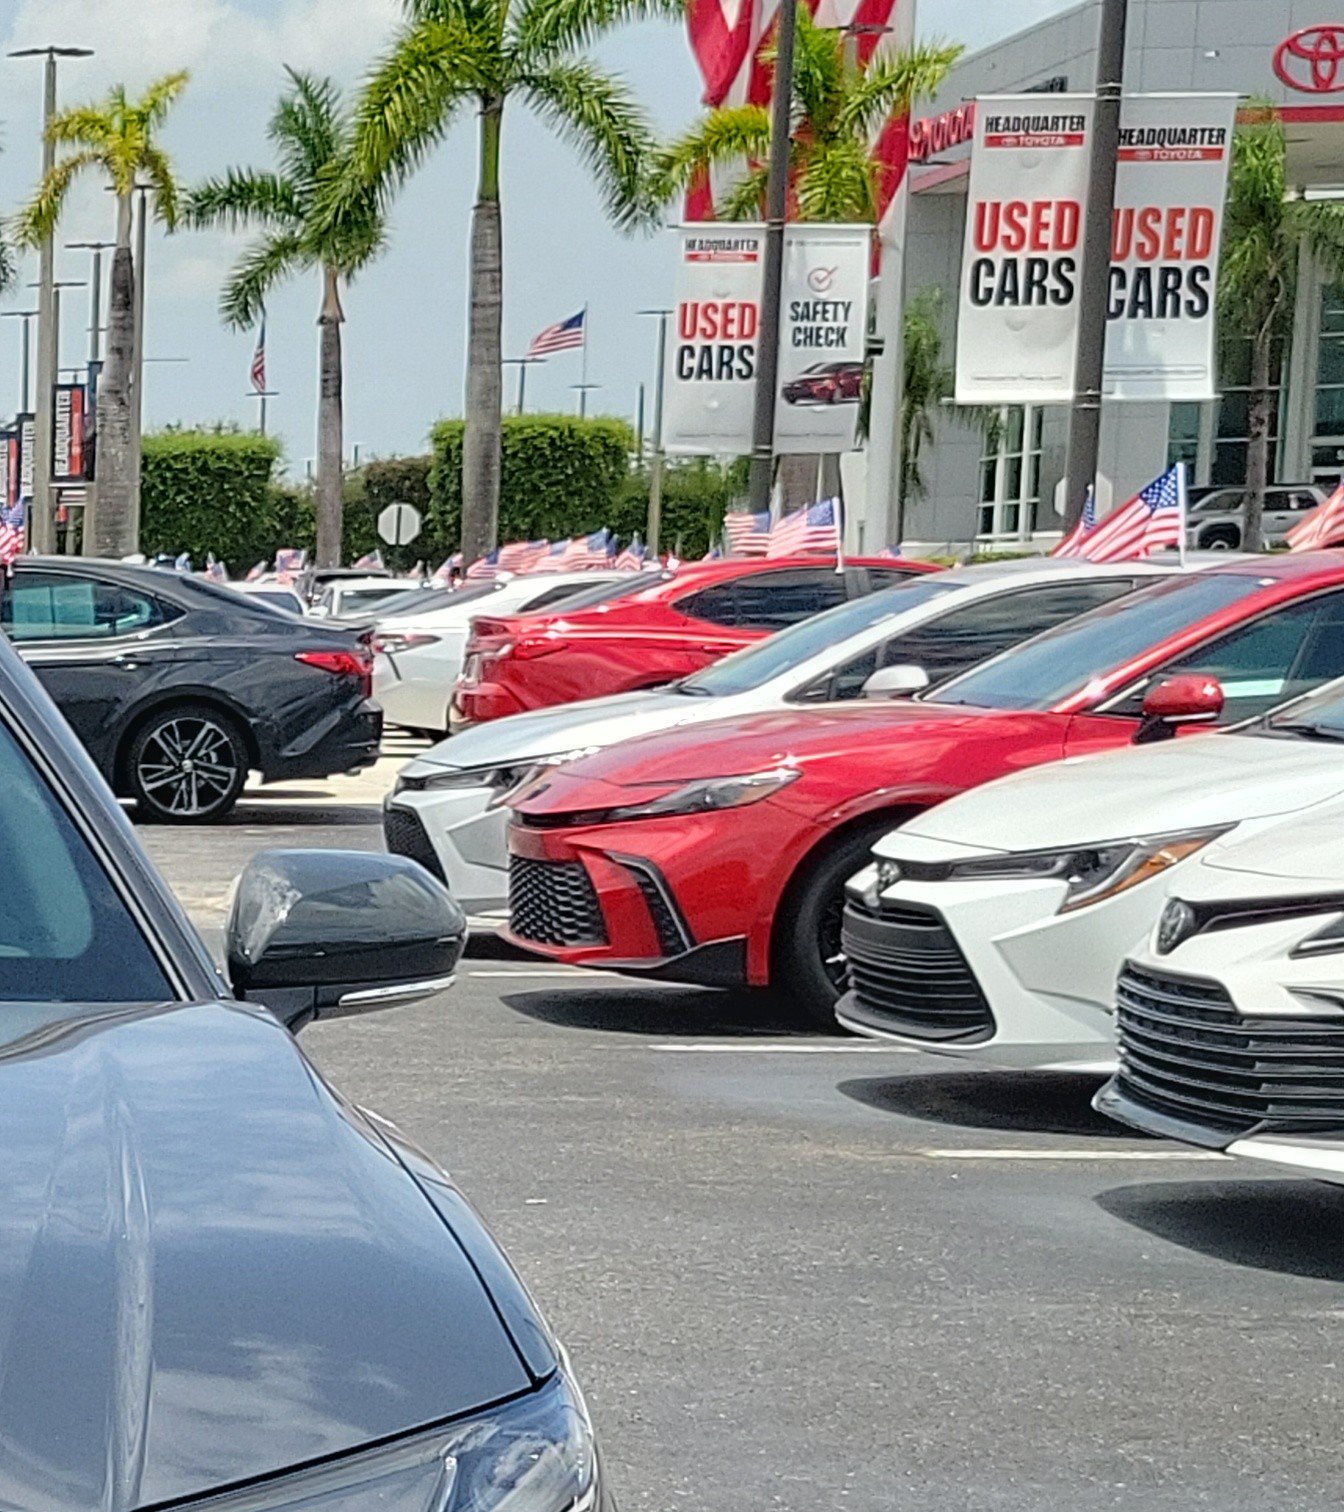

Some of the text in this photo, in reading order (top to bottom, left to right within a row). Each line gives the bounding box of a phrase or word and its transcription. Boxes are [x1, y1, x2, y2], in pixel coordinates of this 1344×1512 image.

[985, 115, 1086, 135] HEADQUARTER
[1118, 128, 1226, 148] HEADQUARTER
[1019, 136, 1065, 146] TOYOTA
[1152, 149, 1202, 160] TOYOTA
[973, 200, 1081, 253] USED
[1111, 207, 1215, 263] USED
[969, 256, 1076, 307] CARS
[1107, 265, 1211, 321] CARS
[679, 302, 757, 341] USED
[790, 301, 852, 323] SAFETY
[792, 326, 848, 348] CHECK
[677, 344, 755, 382] CARS
